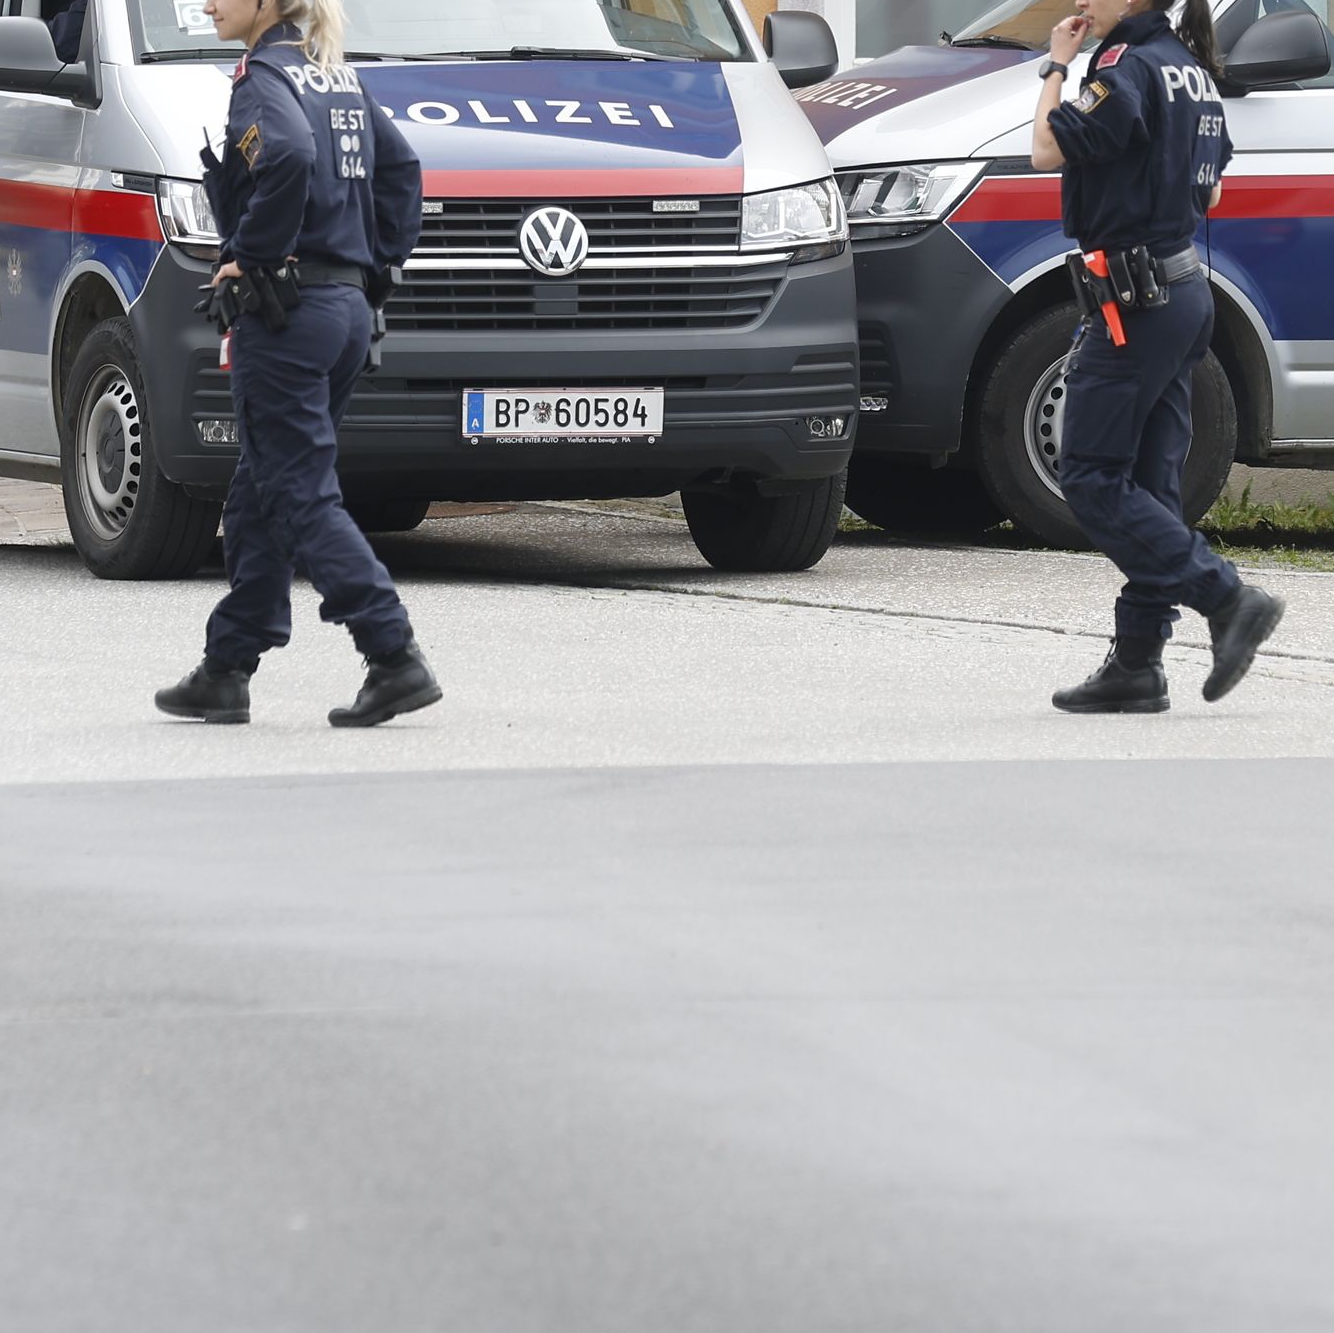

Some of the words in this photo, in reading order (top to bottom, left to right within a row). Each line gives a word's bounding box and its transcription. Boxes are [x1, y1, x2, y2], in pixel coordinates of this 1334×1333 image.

[283, 64, 363, 95] POLIZ
[1160, 65, 1224, 102] POLI
[341, 156, 366, 179] 614
[1197, 163, 1216, 185] 614
[495, 398, 530, 428] BP
[555, 397, 648, 428] 60584
[567, 436, 587, 444] Vielfalt,
